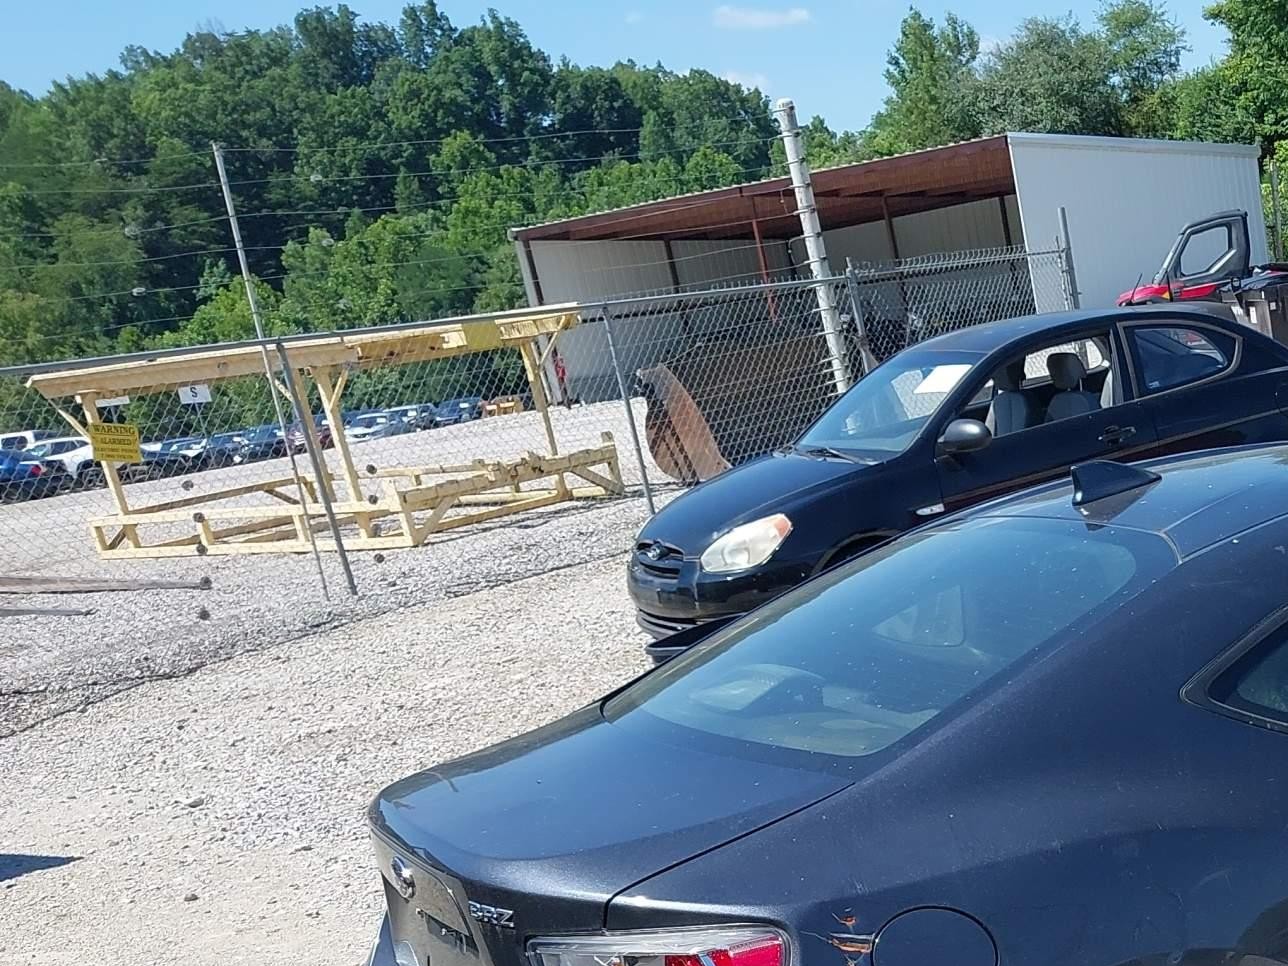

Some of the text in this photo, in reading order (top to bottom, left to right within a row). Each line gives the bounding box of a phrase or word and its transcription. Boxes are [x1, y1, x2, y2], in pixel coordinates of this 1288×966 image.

[190, 386, 198, 398] S
[93, 425, 135, 435] WARNING
[468, 900, 515, 928] BRZ
